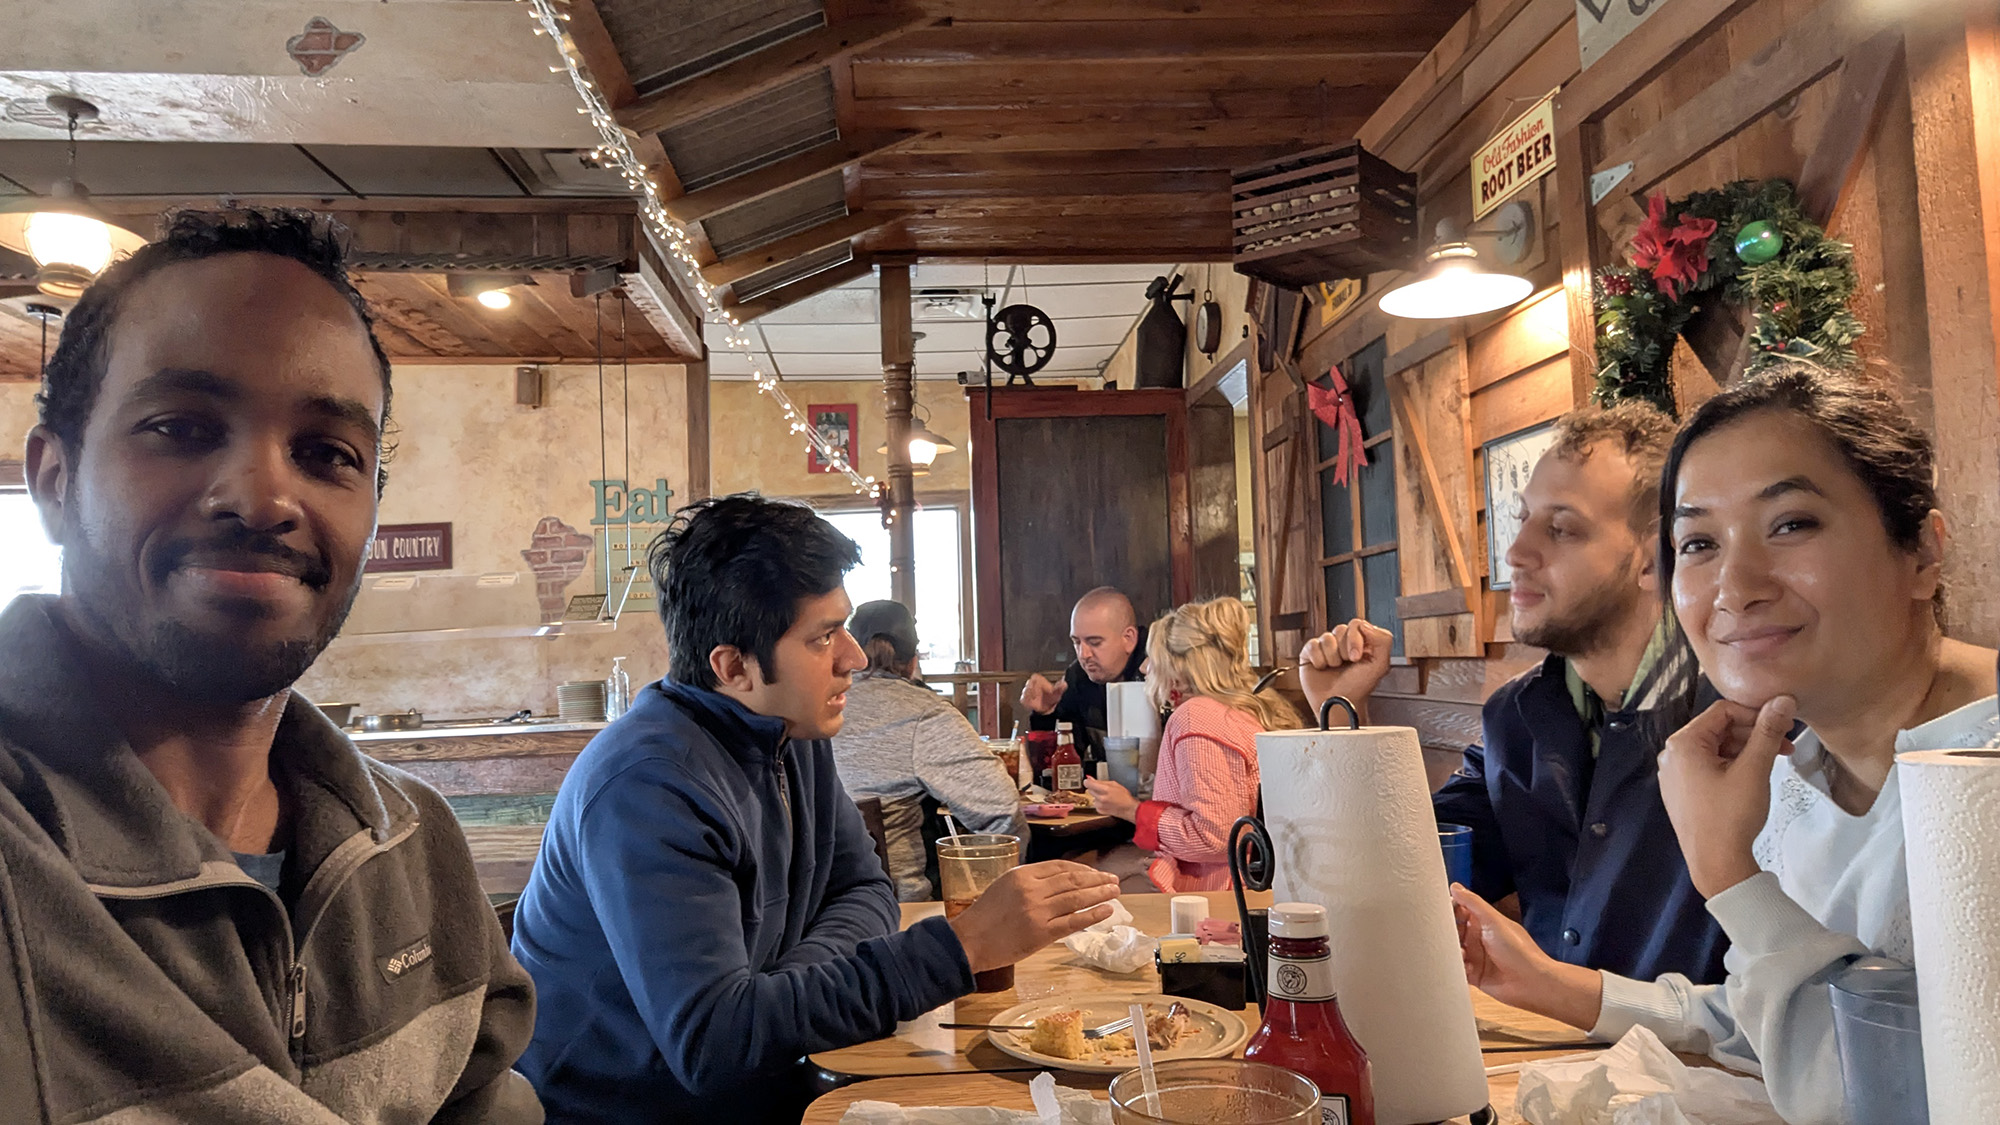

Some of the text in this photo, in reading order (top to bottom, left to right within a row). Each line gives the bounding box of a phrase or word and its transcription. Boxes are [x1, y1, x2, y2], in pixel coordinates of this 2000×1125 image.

[1481, 133, 1552, 204] ROOT BEER
[1482, 118, 1545, 175] Old Fashion
[589, 478, 675, 525] Eat
[393, 536, 440, 560] COUNTRY
